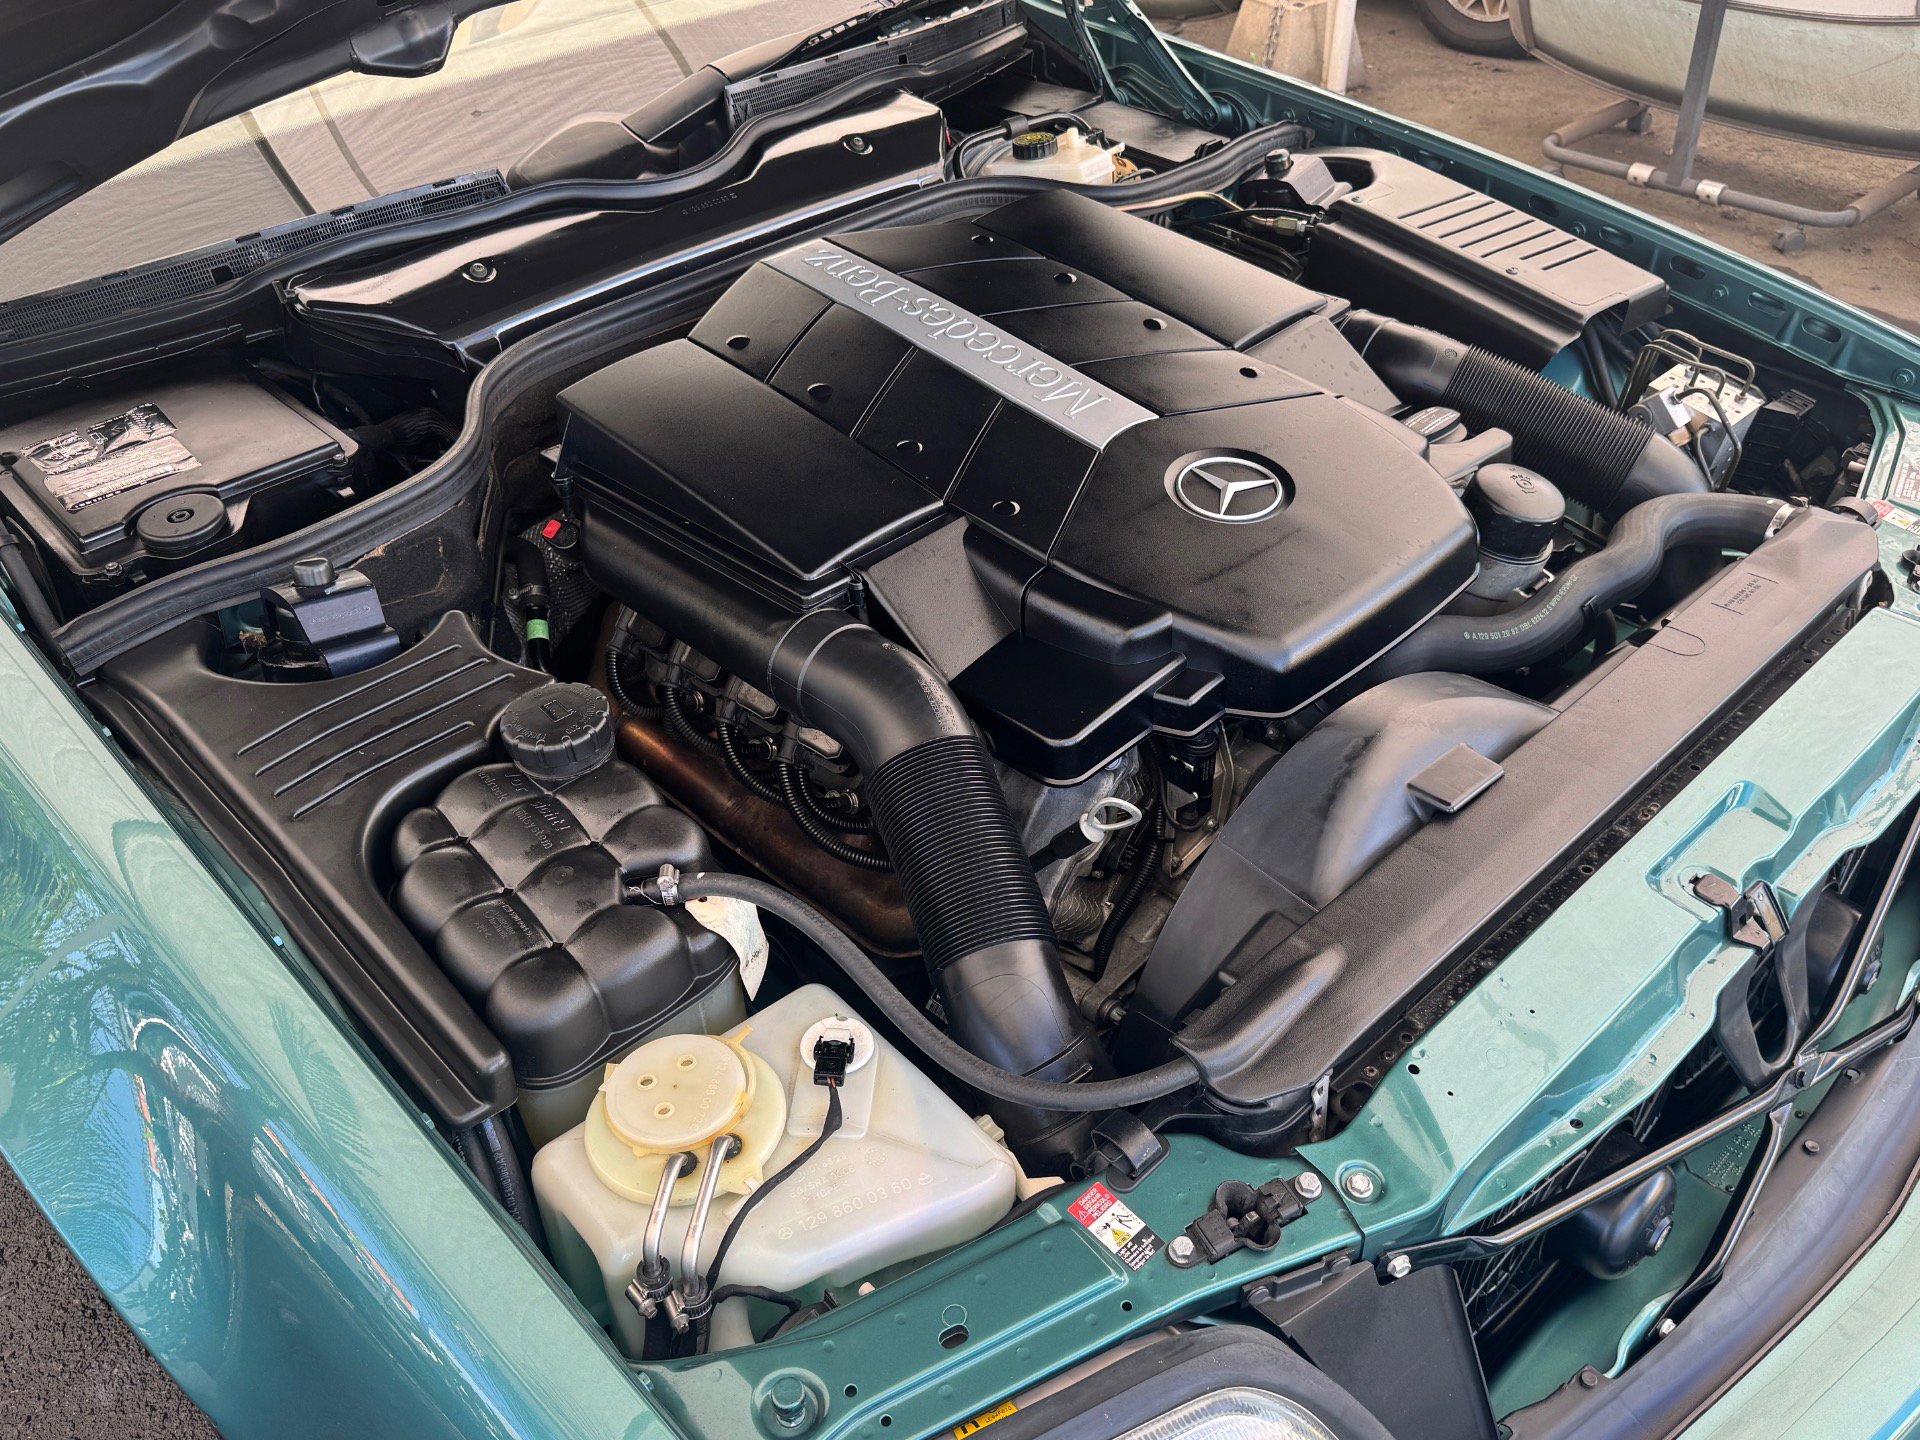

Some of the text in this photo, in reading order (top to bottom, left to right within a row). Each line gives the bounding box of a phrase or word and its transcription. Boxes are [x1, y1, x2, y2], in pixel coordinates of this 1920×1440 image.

[802, 249, 1112, 420] Mercedes-Benz
[797, 1176, 913, 1232] 129 860 03 60
[1078, 1187, 1098, 1206] DANGER
[1082, 1192, 1102, 1210] GEFAHR
[1086, 1192, 1110, 1214] PERICOLO
[1091, 1199, 1112, 1218] PELIGRO
